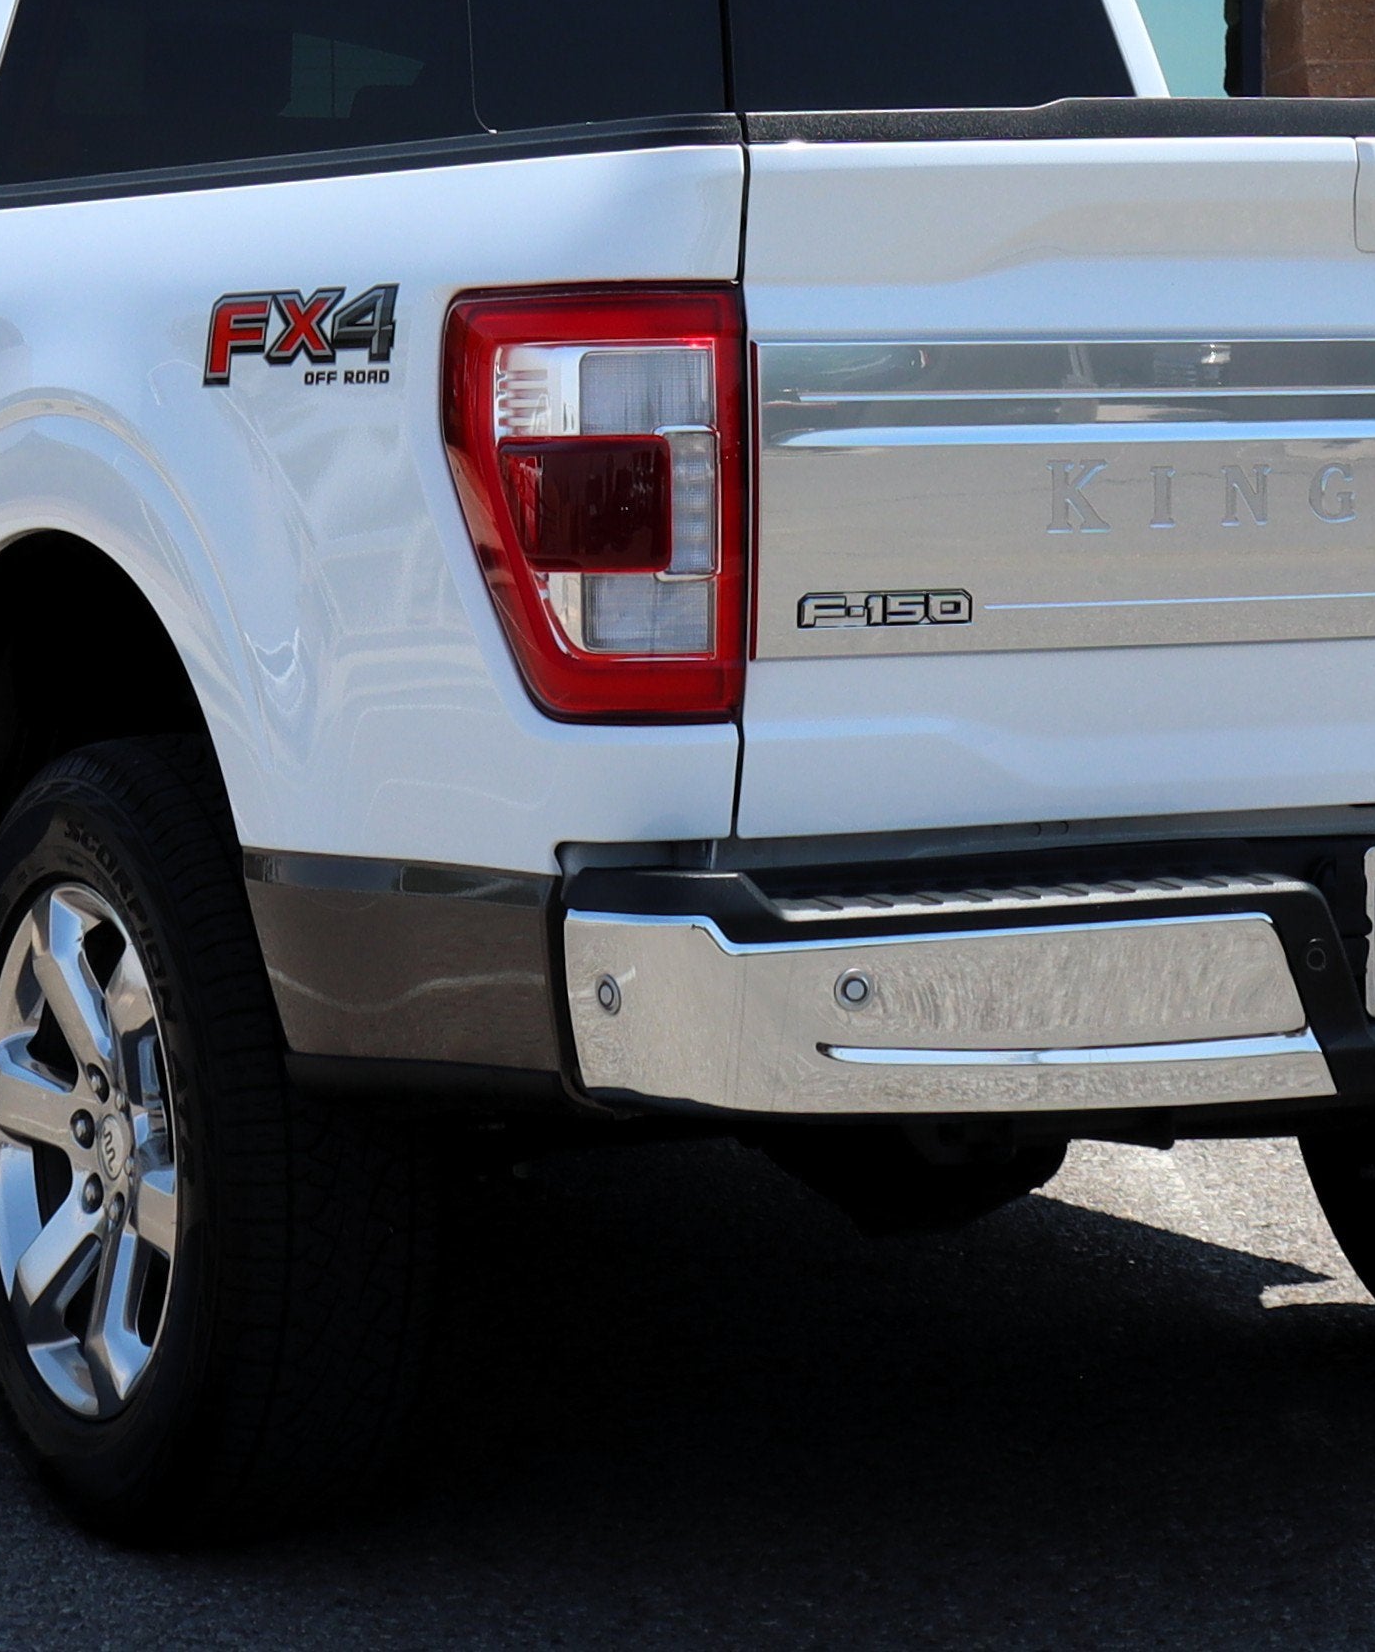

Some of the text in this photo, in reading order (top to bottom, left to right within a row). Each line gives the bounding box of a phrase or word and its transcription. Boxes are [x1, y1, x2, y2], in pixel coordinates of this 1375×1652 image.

[202, 283, 401, 388] FX4
[304, 369, 390, 386] OFF ROAD
[1045, 458, 1357, 535] KING
[797, 588, 973, 629] F-150
